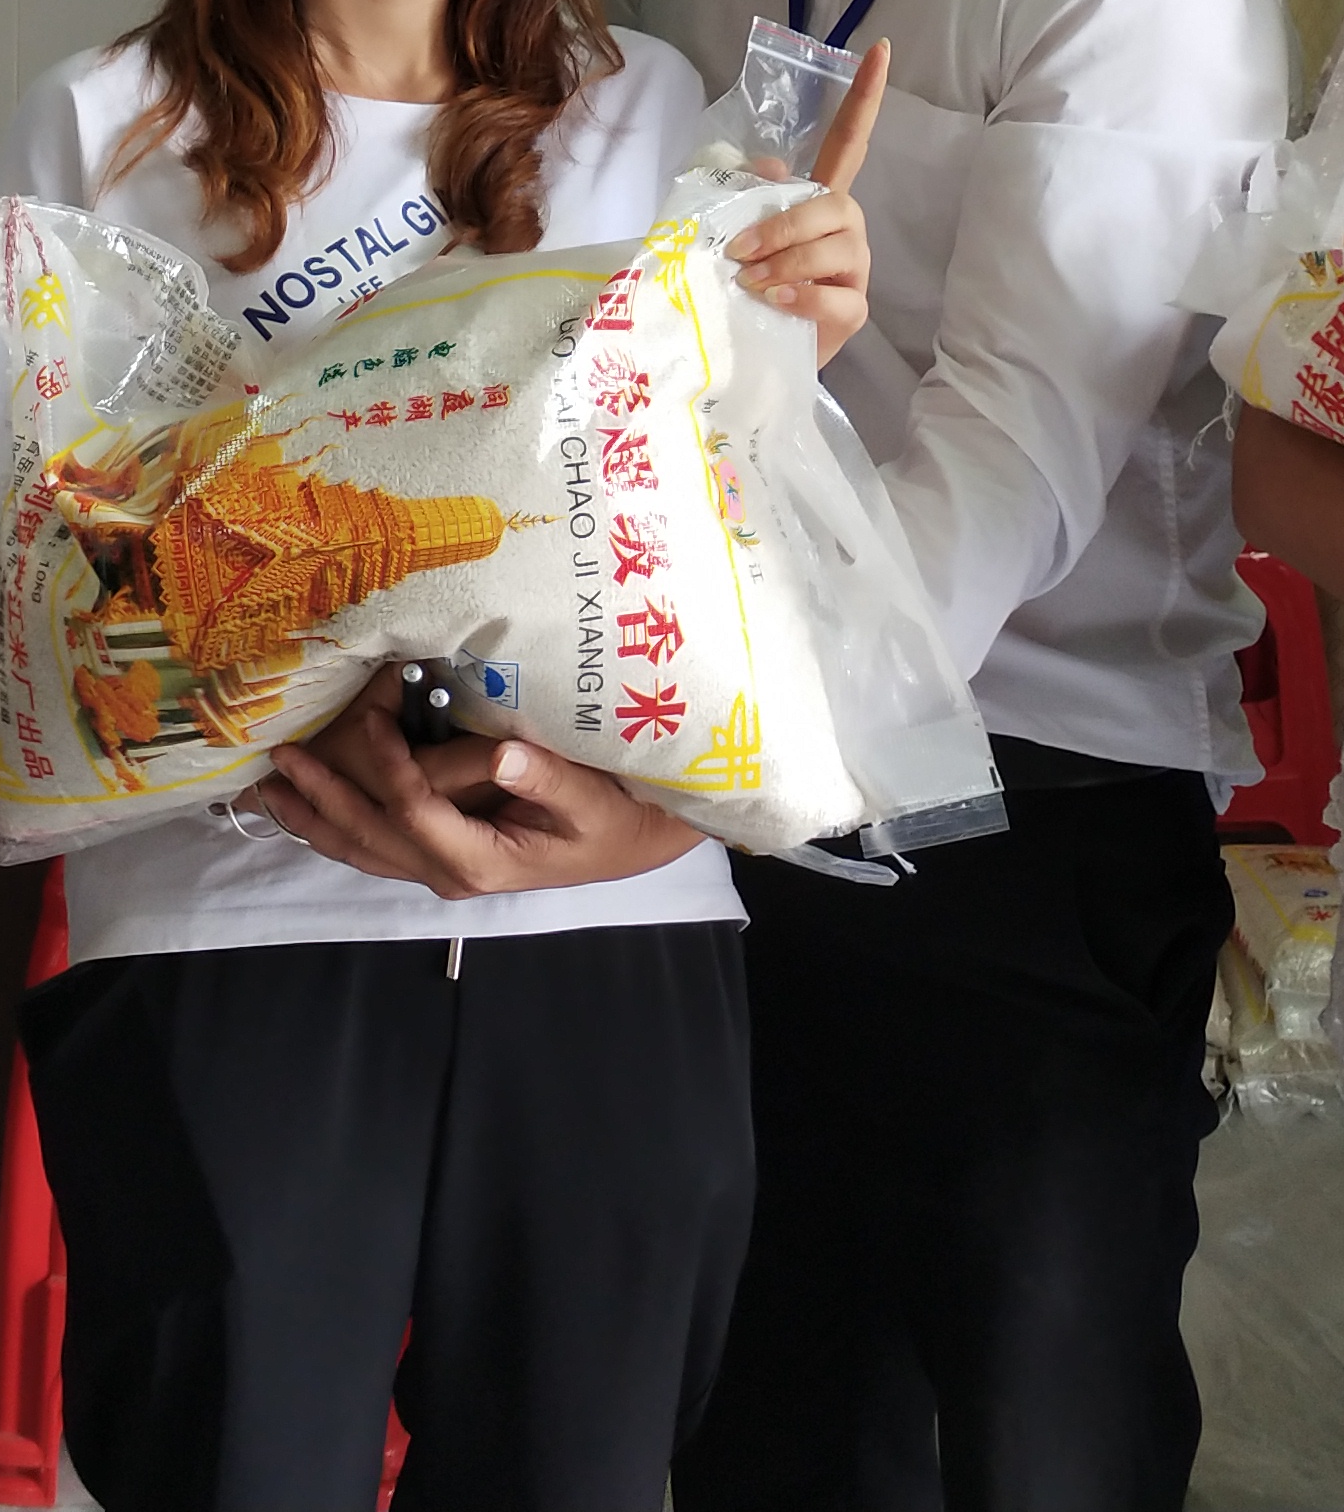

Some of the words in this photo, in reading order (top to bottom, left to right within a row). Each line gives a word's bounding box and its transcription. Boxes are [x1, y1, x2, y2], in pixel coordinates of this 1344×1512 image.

[241, 191, 448, 341] NOSTALGI
[560, 436, 596, 540] CHAO
[586, 267, 687, 745] 国泰超级香米
[30, 560, 51, 605] 10kg
[571, 551, 600, 577] JI
[568, 591, 609, 693] XIANG
[572, 702, 604, 733] MI
